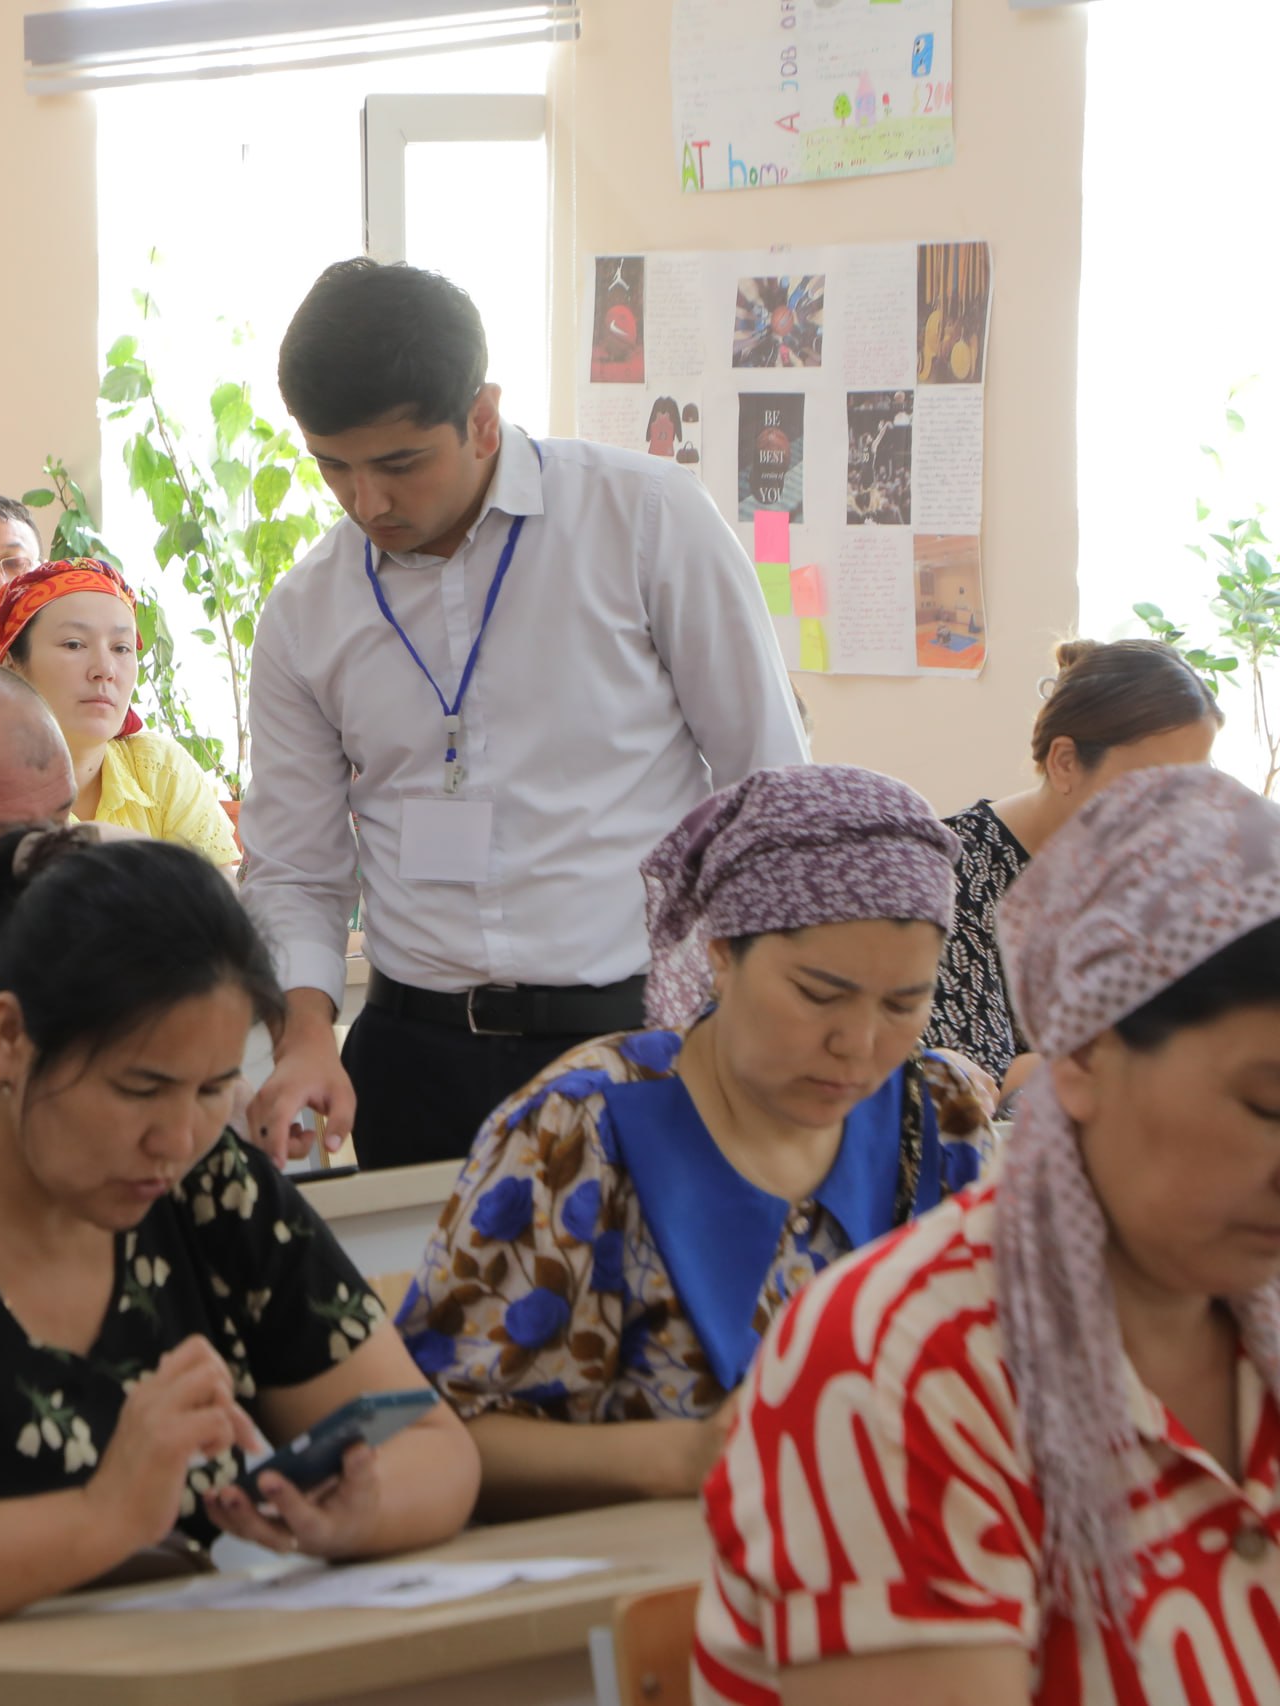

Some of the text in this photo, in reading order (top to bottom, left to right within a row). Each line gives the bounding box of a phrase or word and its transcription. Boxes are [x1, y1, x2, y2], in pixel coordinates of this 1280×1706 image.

[780, 45, 799, 92] JOB
[774, 111, 801, 134] A
[681, 139, 711, 192] AT
[764, 409, 781, 427] BE
[759, 449, 786, 464] BEST
